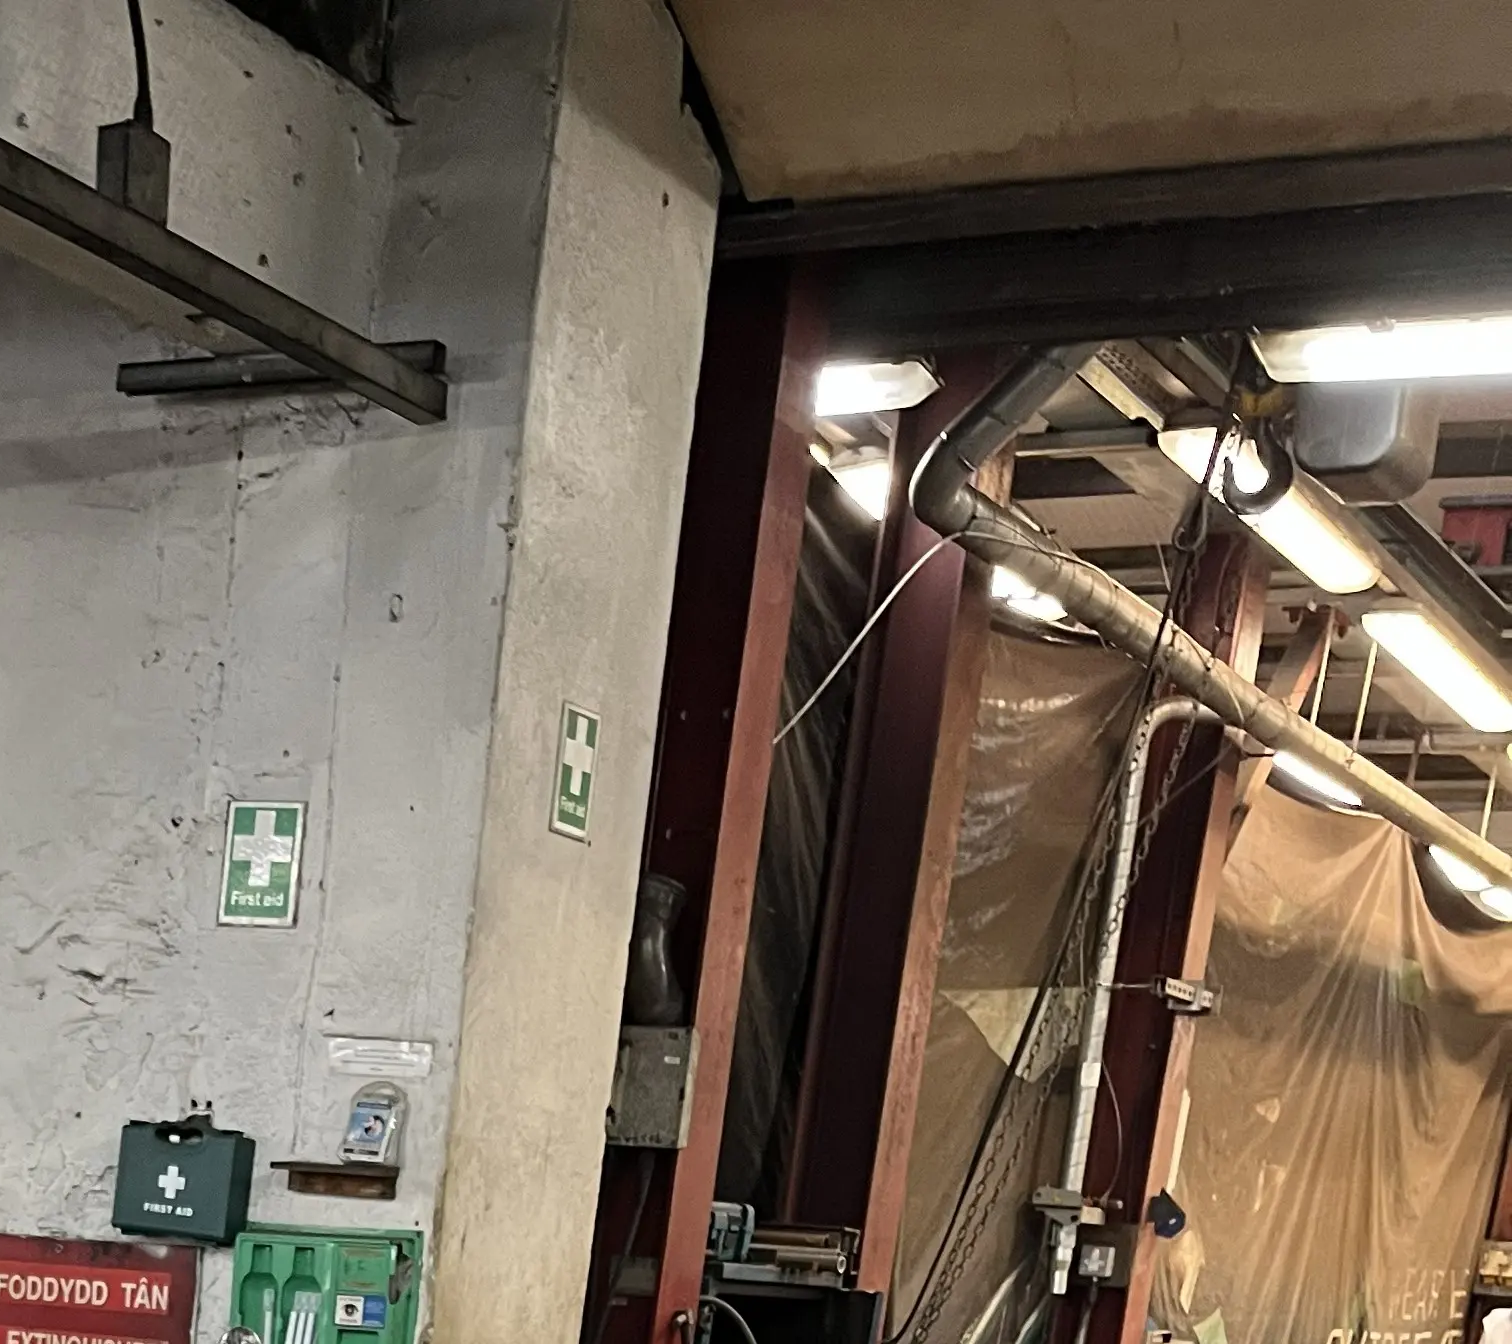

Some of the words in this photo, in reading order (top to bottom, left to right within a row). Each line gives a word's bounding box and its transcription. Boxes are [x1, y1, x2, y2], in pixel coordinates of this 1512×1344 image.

[230, 890, 261, 906] First
[263, 891, 285, 907] aid
[143, 1202, 173, 1214] FIRST
[175, 1206, 193, 1217] AID
[121, 1277, 169, 1311] TÂN
